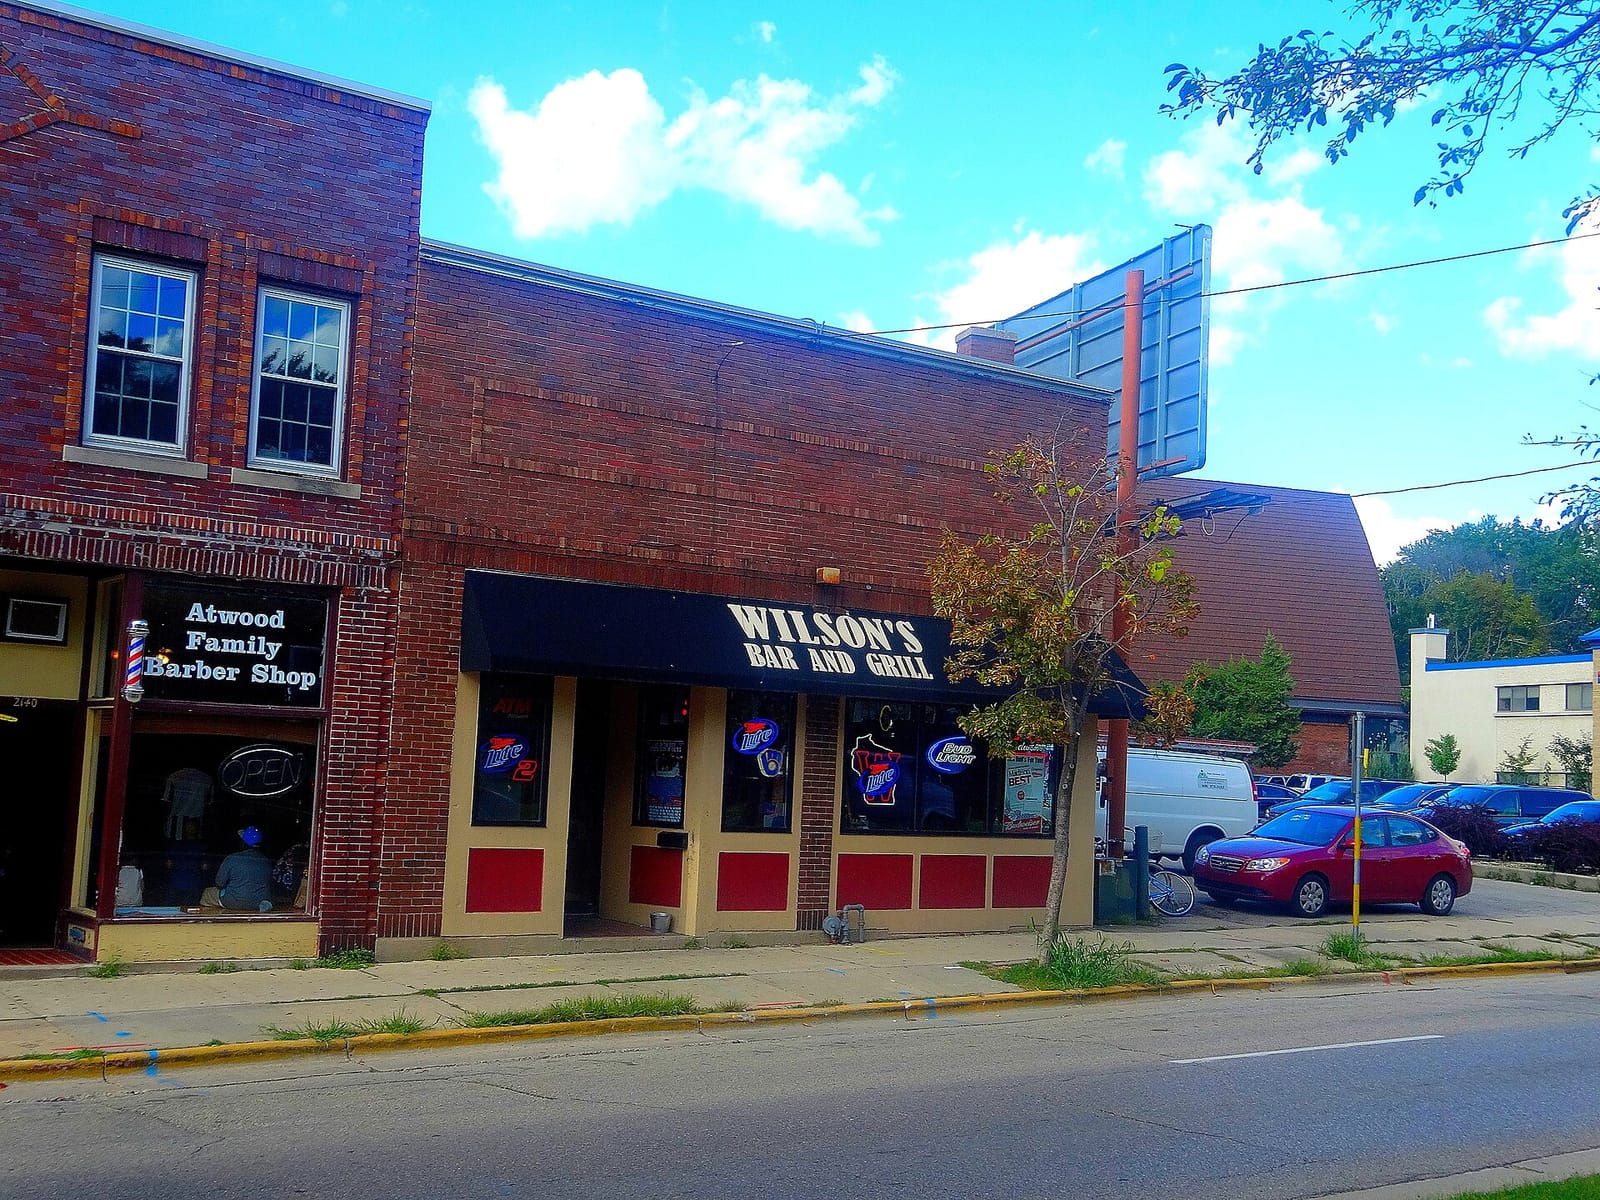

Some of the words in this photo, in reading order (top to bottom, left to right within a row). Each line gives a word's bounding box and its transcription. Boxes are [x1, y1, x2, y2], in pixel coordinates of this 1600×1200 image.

[185, 602, 286, 629] Atwood
[727, 603, 924, 653] WILSON'S
[185, 631, 283, 660] Family
[144, 656, 241, 681] Barber
[251, 663, 317, 690] Shop
[743, 643, 800, 670] BAR
[808, 648, 856, 674] AND
[866, 652, 934, 680] GRILL
[740, 728, 772, 751] Lite
[484, 742, 523, 769] Lite
[222, 757, 301, 788] OPEN
[512, 759, 538, 782] 2
[866, 768, 895, 793] Lite
[1008, 774, 1032, 787] BEST
